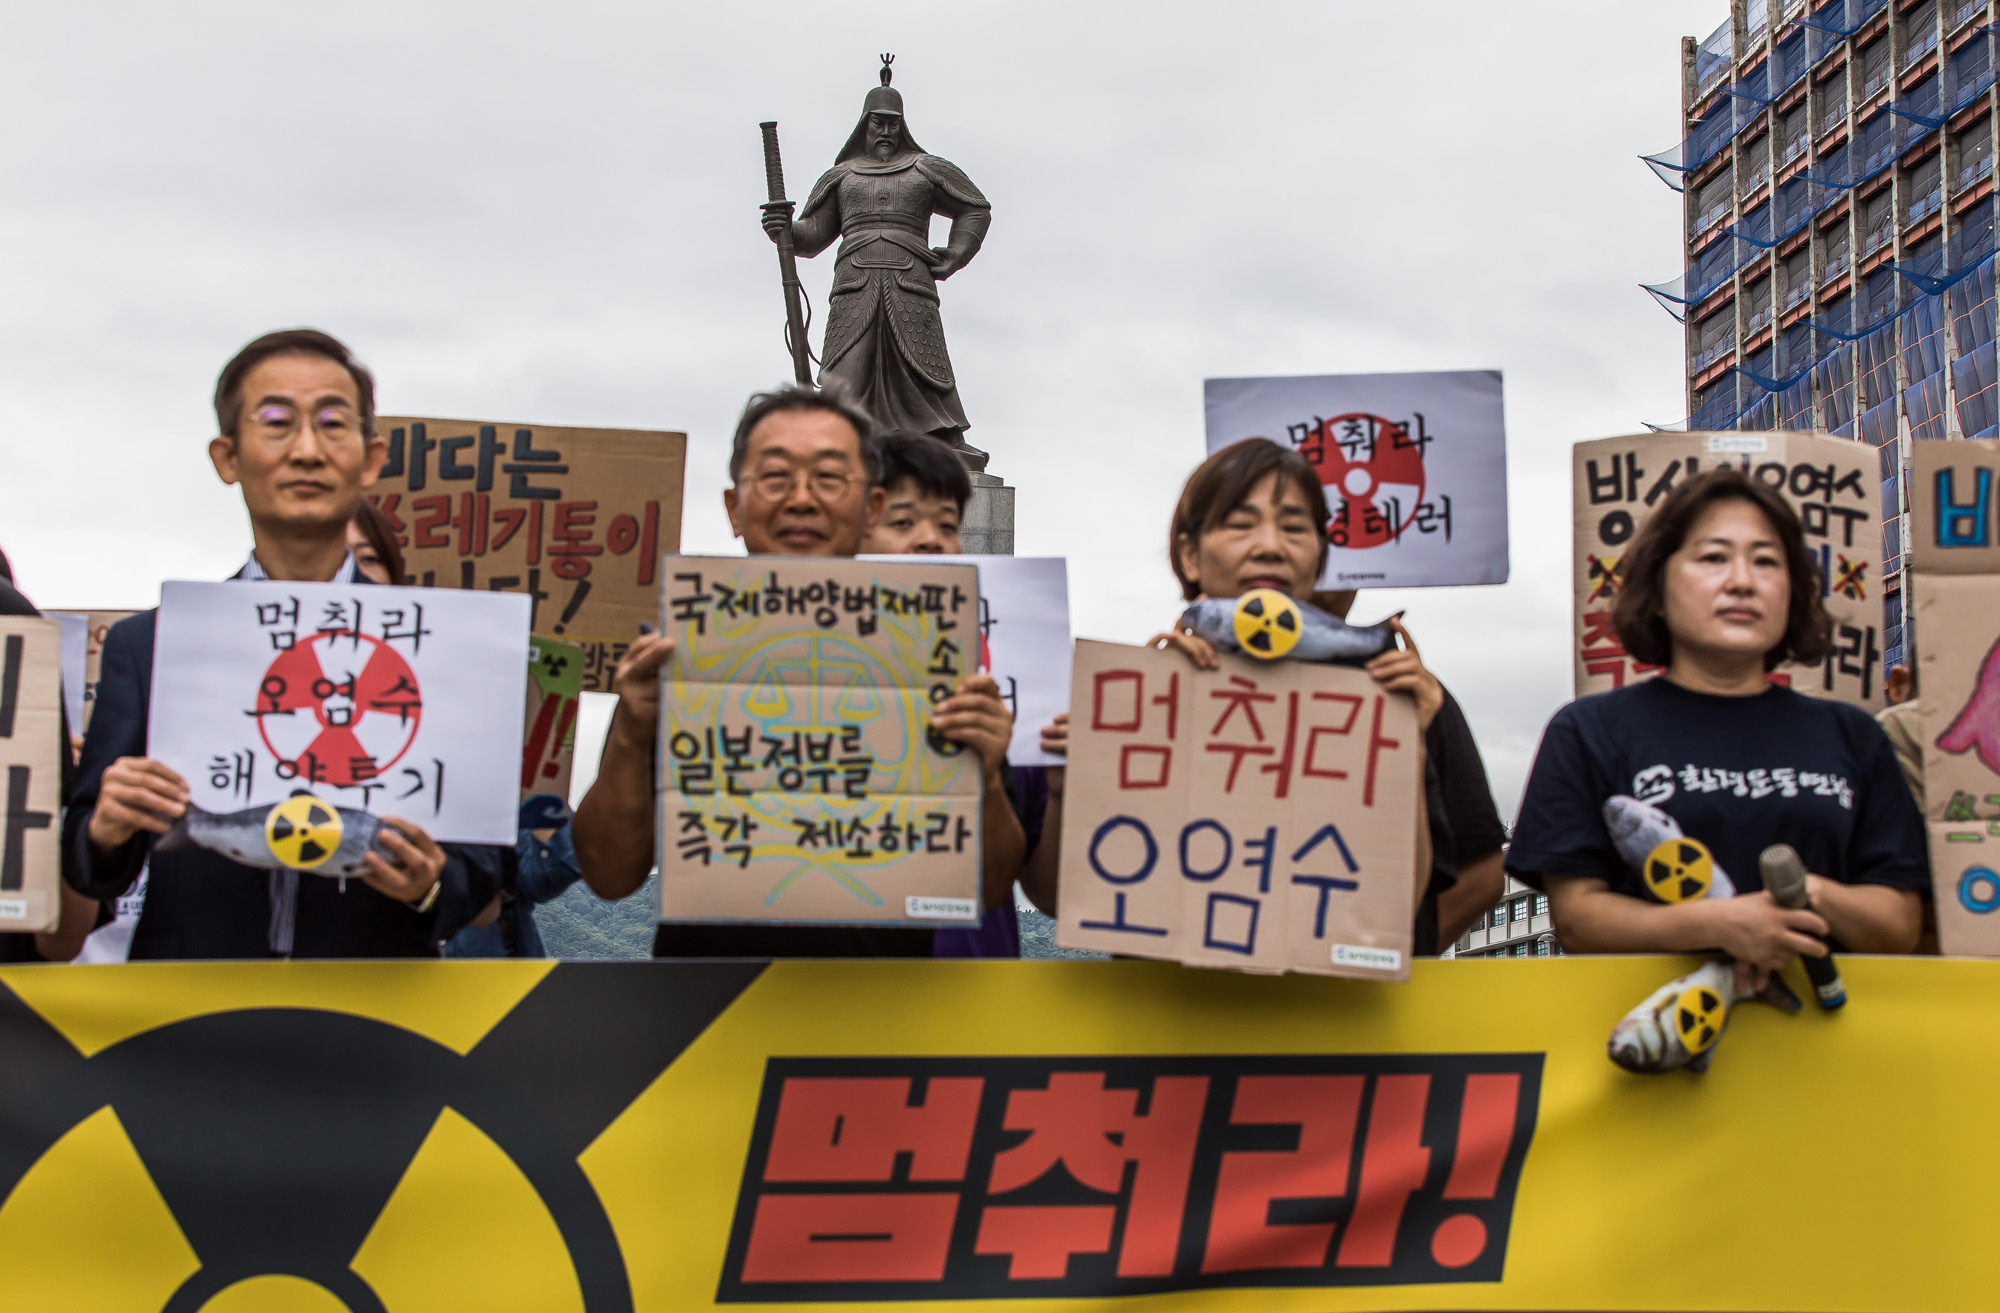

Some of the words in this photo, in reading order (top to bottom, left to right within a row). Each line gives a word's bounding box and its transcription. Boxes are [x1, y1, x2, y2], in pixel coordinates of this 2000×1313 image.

[1287, 412, 1433, 465] 멈춰라
[1327, 494, 1452, 547] 경테러
[256, 595, 431, 657] 멈춰라
[244, 670, 423, 729] 오염수
[670, 725, 873, 799] 일본정부를
[1091, 668, 1400, 807] 멈춰라
[208, 748, 444, 817] 해양투기
[677, 811, 759, 869] 즉각
[792, 812, 971, 859] 제소하라
[1079, 815, 1360, 957] 오염수
[740, 1071, 1521, 1283] 멈춰라!
